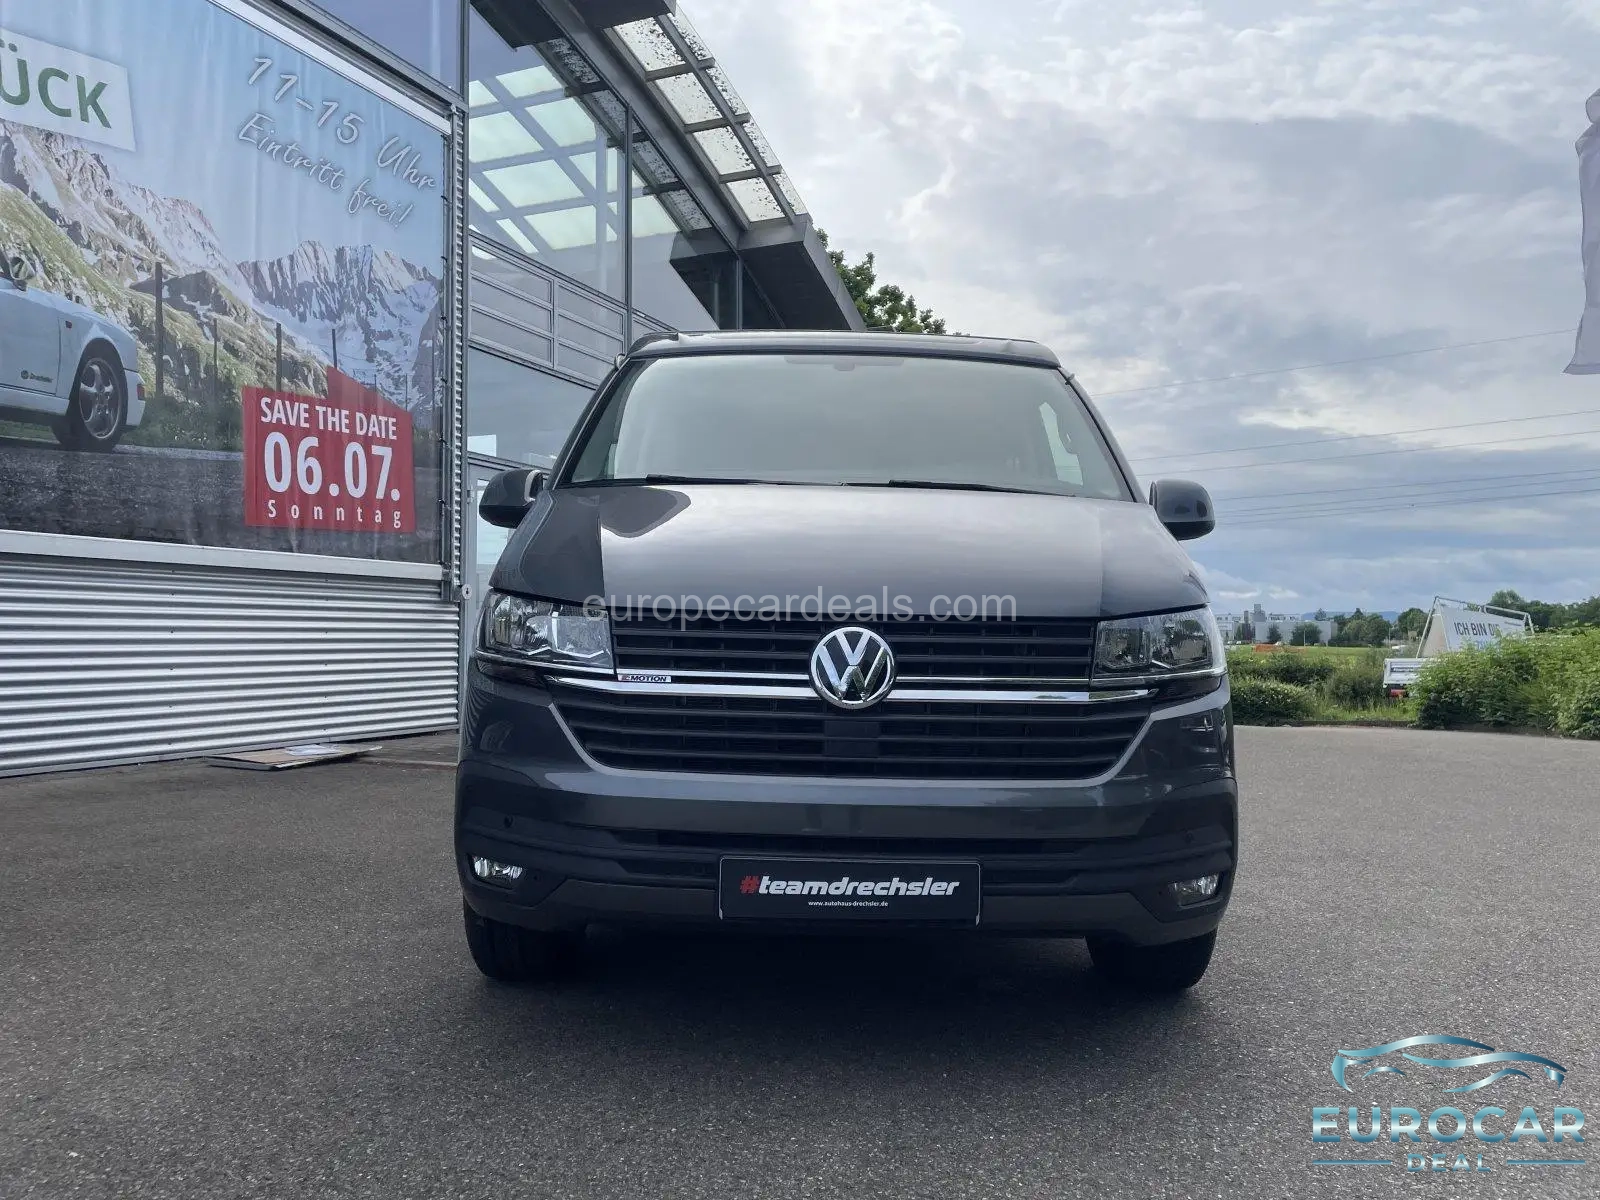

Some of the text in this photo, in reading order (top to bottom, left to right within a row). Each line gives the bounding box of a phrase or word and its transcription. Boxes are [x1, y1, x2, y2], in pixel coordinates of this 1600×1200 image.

[0, 39, 112, 129] ÜCK
[246, 57, 437, 190] 11-15 Uhr
[237, 112, 415, 230] Eintritt frei!
[260, 396, 398, 440] SAVE THE DATE
[263, 431, 401, 501] 06.07.
[267, 498, 402, 529] Sonntag
[1454, 622, 1470, 636] ICH
[1471, 622, 1487, 636] BIN
[739, 875, 960, 897] #teamdrechsler
[808, 900, 889, 908] www.autohaus-drechsler.de
